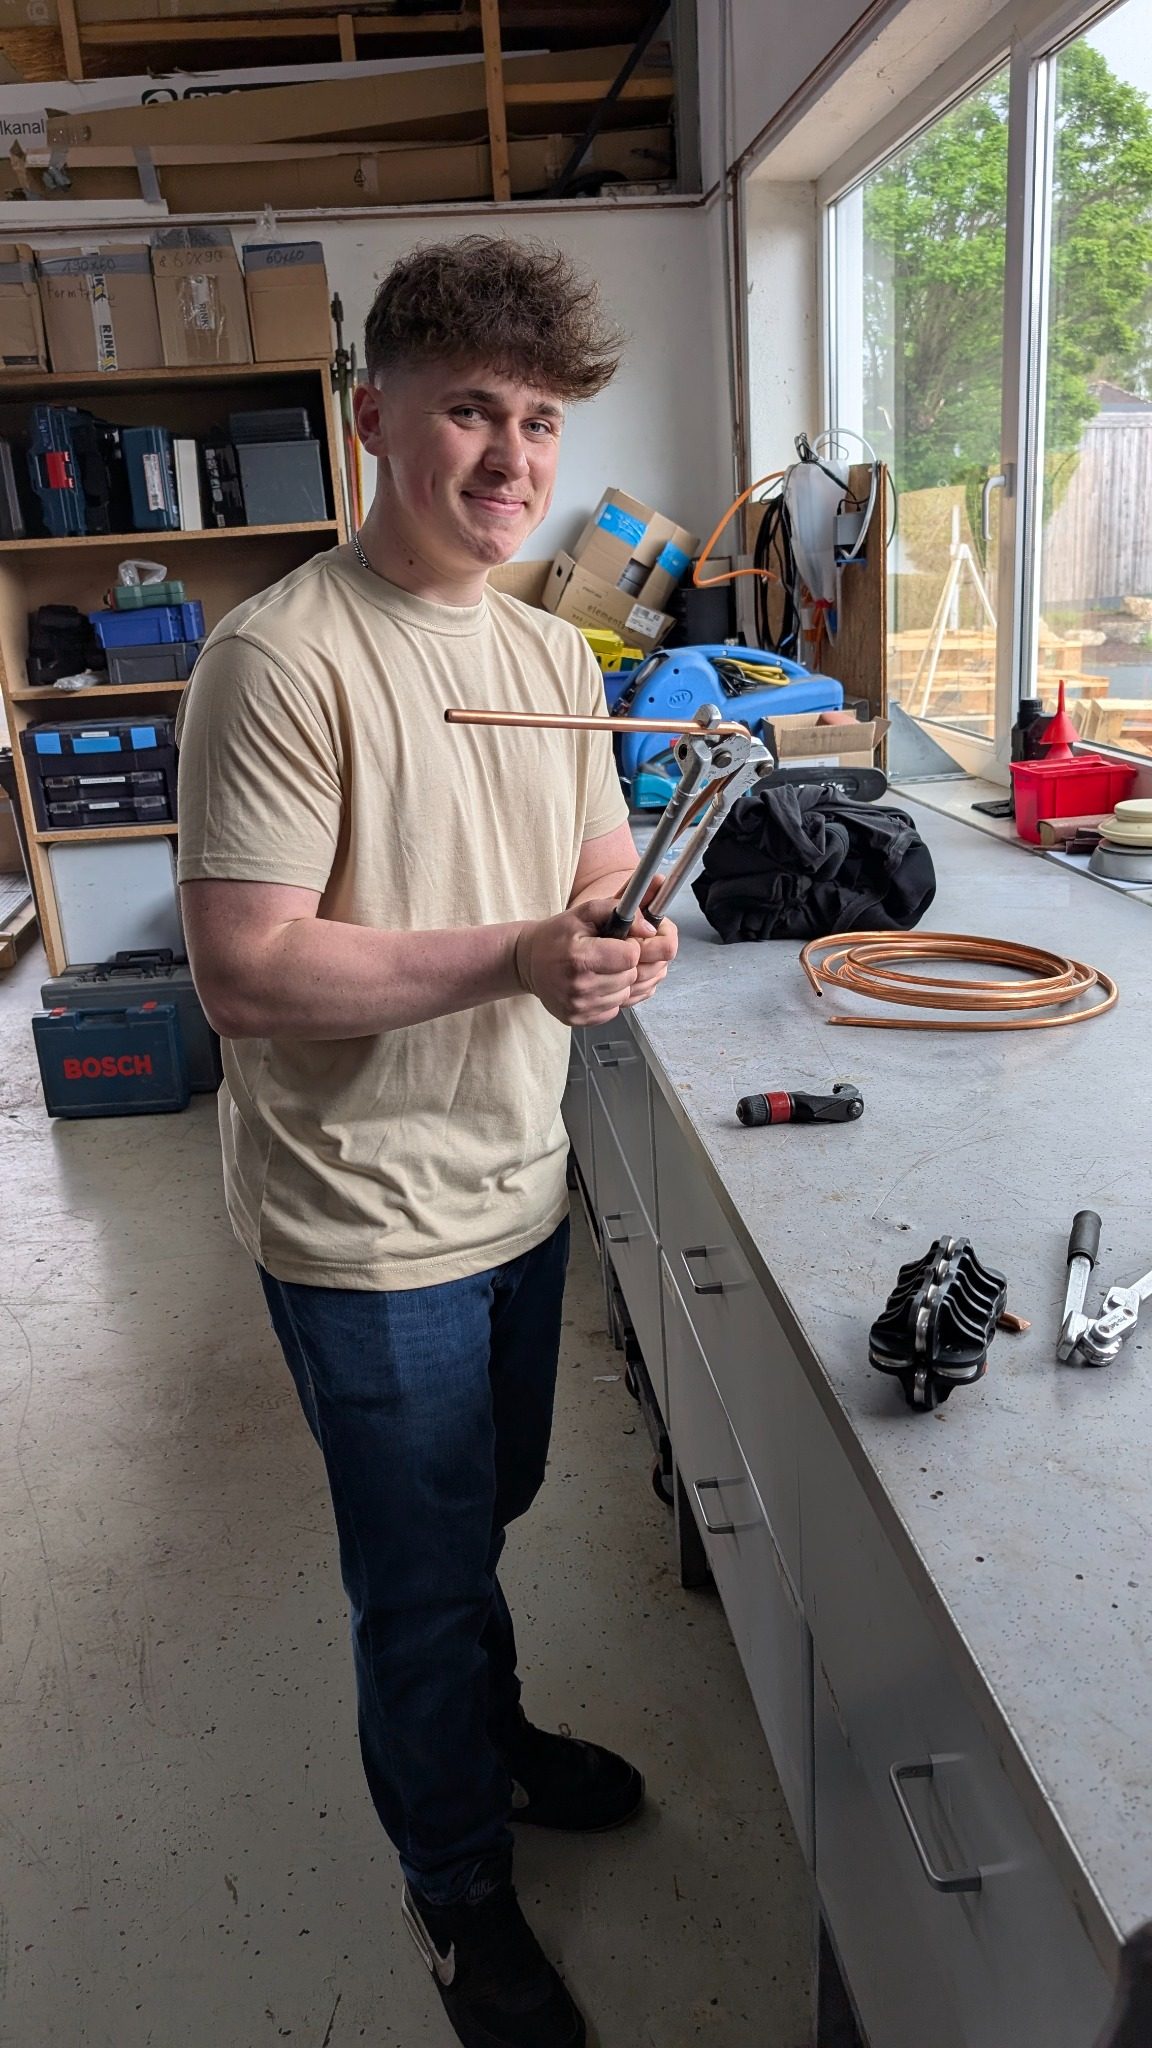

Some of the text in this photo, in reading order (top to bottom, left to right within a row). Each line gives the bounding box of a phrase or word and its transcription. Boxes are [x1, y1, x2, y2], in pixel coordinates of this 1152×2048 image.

[199, 303, 209, 328] RINK
[102, 325, 115, 358] RINK
[63, 1055, 153, 1079] BOSCH
